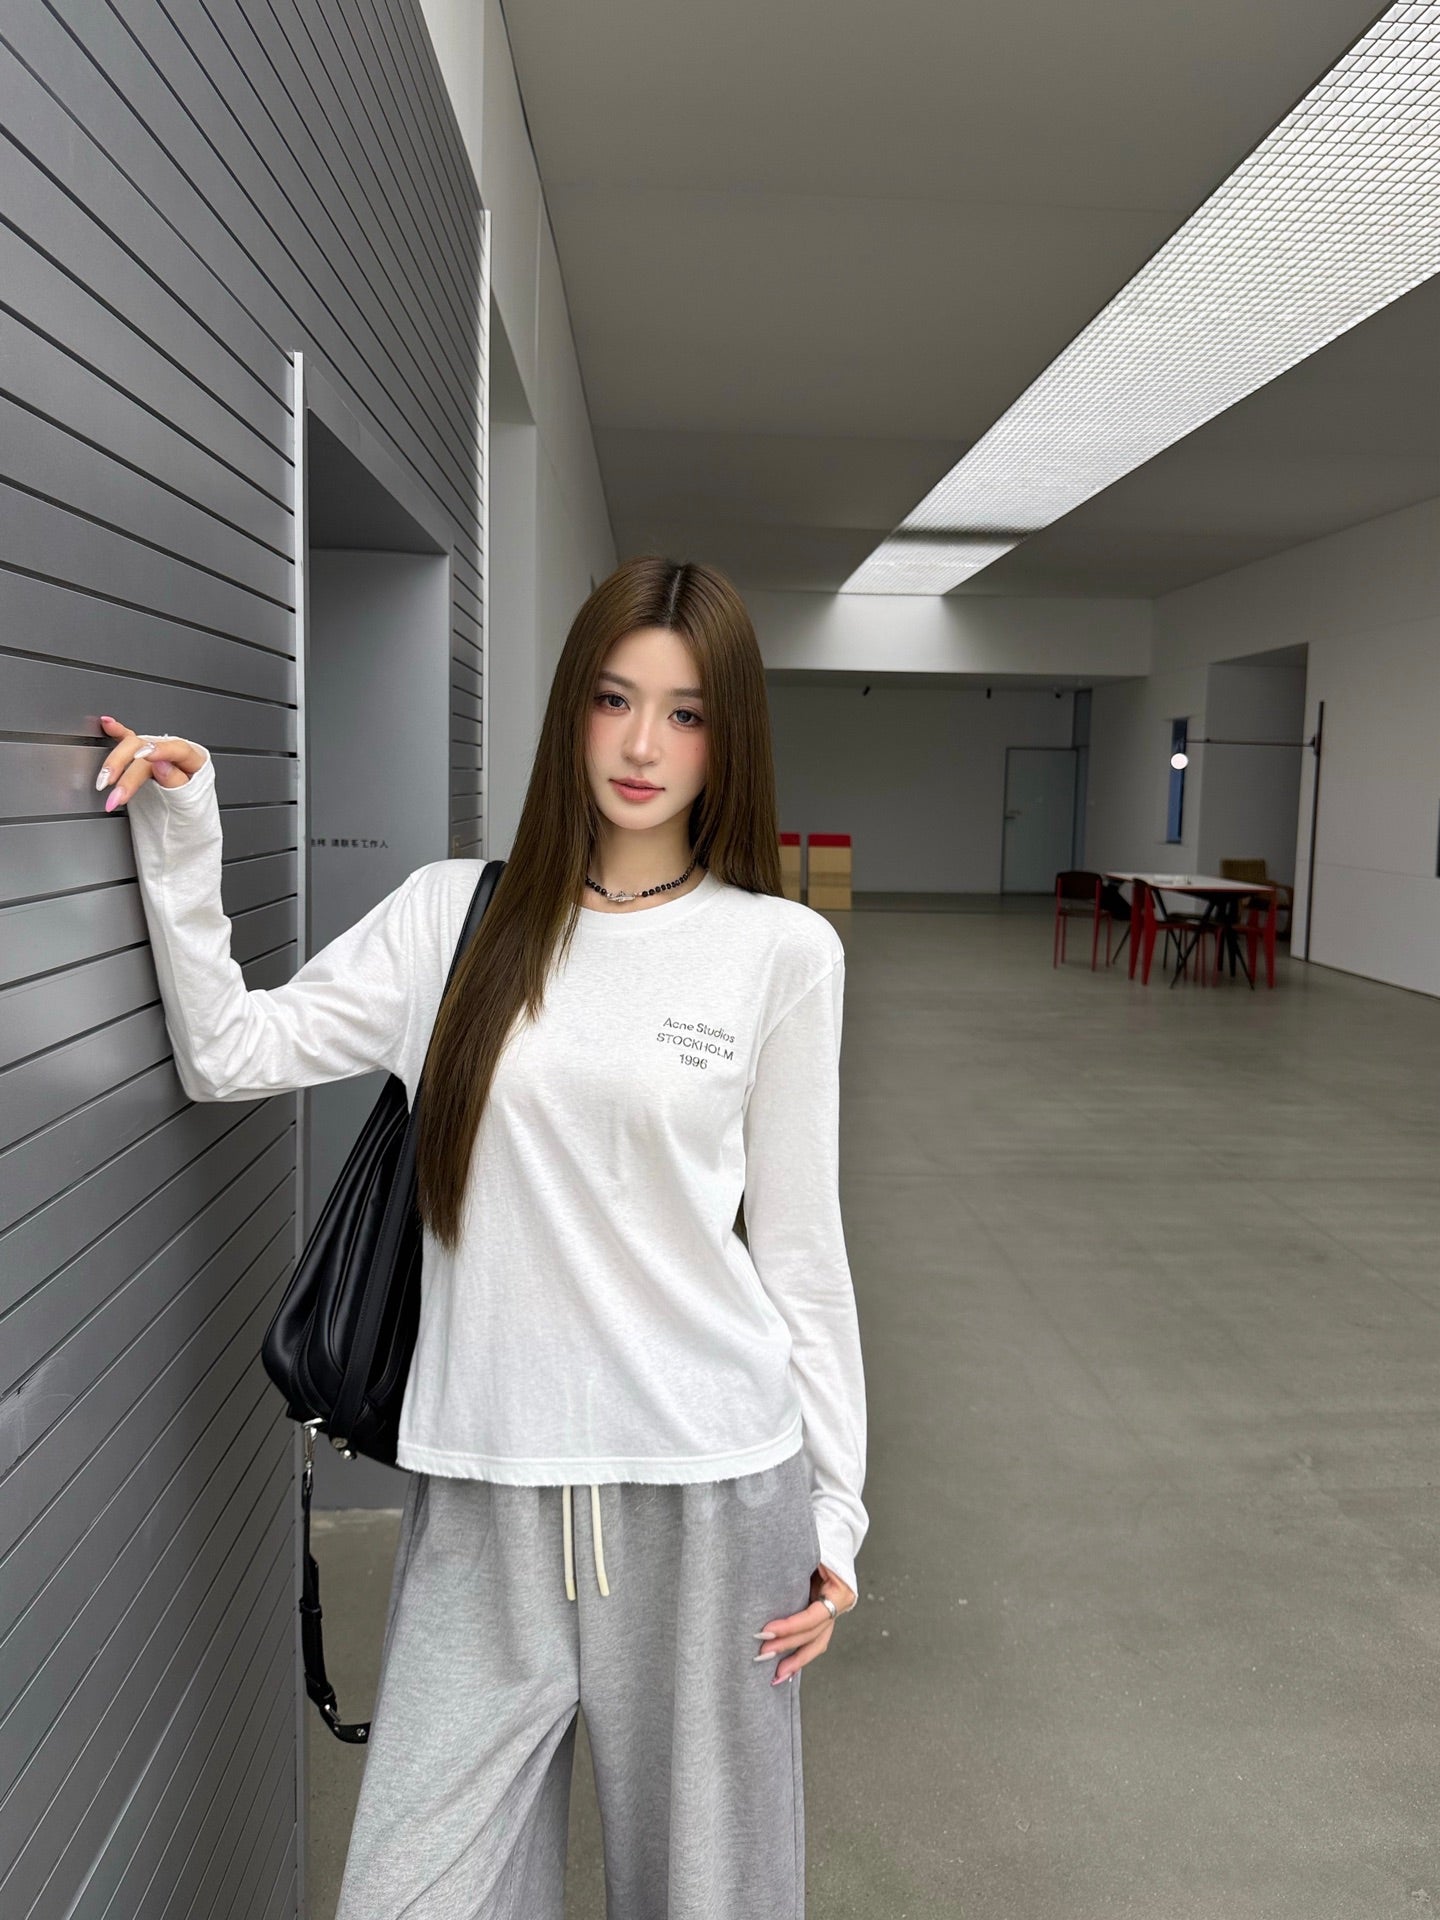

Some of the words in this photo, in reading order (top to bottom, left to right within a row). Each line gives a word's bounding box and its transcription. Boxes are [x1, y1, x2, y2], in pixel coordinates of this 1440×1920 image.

[663, 1017, 694, 1031] Acne
[696, 1022, 735, 1043] Studios
[656, 1032, 734, 1061] STOCKHOLM
[679, 1053, 708, 1070] 1996
